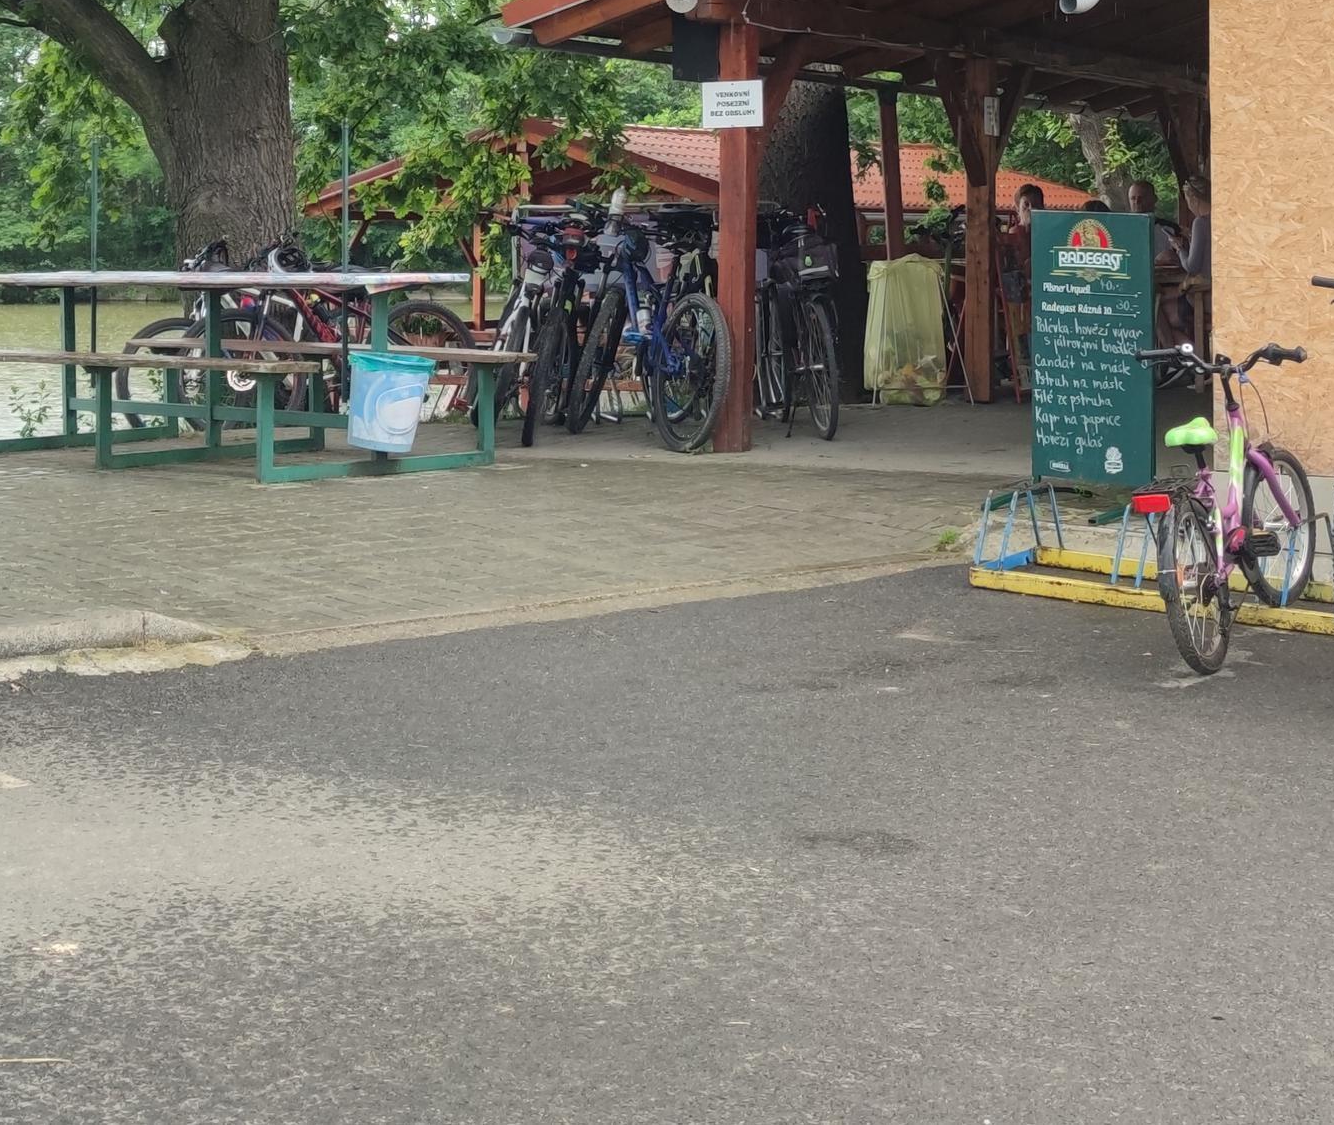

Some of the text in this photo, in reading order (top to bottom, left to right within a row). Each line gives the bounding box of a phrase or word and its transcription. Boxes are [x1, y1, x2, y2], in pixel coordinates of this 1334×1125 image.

[1058, 251, 1123, 271] RADEGAST
[1043, 282, 1065, 293] Pilsner
[1065, 284, 1091, 296] Urquell
[1041, 301, 1076, 314] Radegast
[1077, 303, 1102, 314] Rázná
[1103, 306, 1112, 315] 10
[1074, 317, 1110, 336] hovězí
[1112, 323, 1143, 344] vývar
[1044, 336, 1051, 346] s
[1034, 353, 1075, 369] Candát
[1081, 360, 1096, 371] na
[1034, 368, 1069, 387] Pstruh
[1073, 378, 1089, 388] na
[1034, 388, 1113, 412] Filé ze pstruha
[1035, 406, 1121, 434] Kapr na paprice
